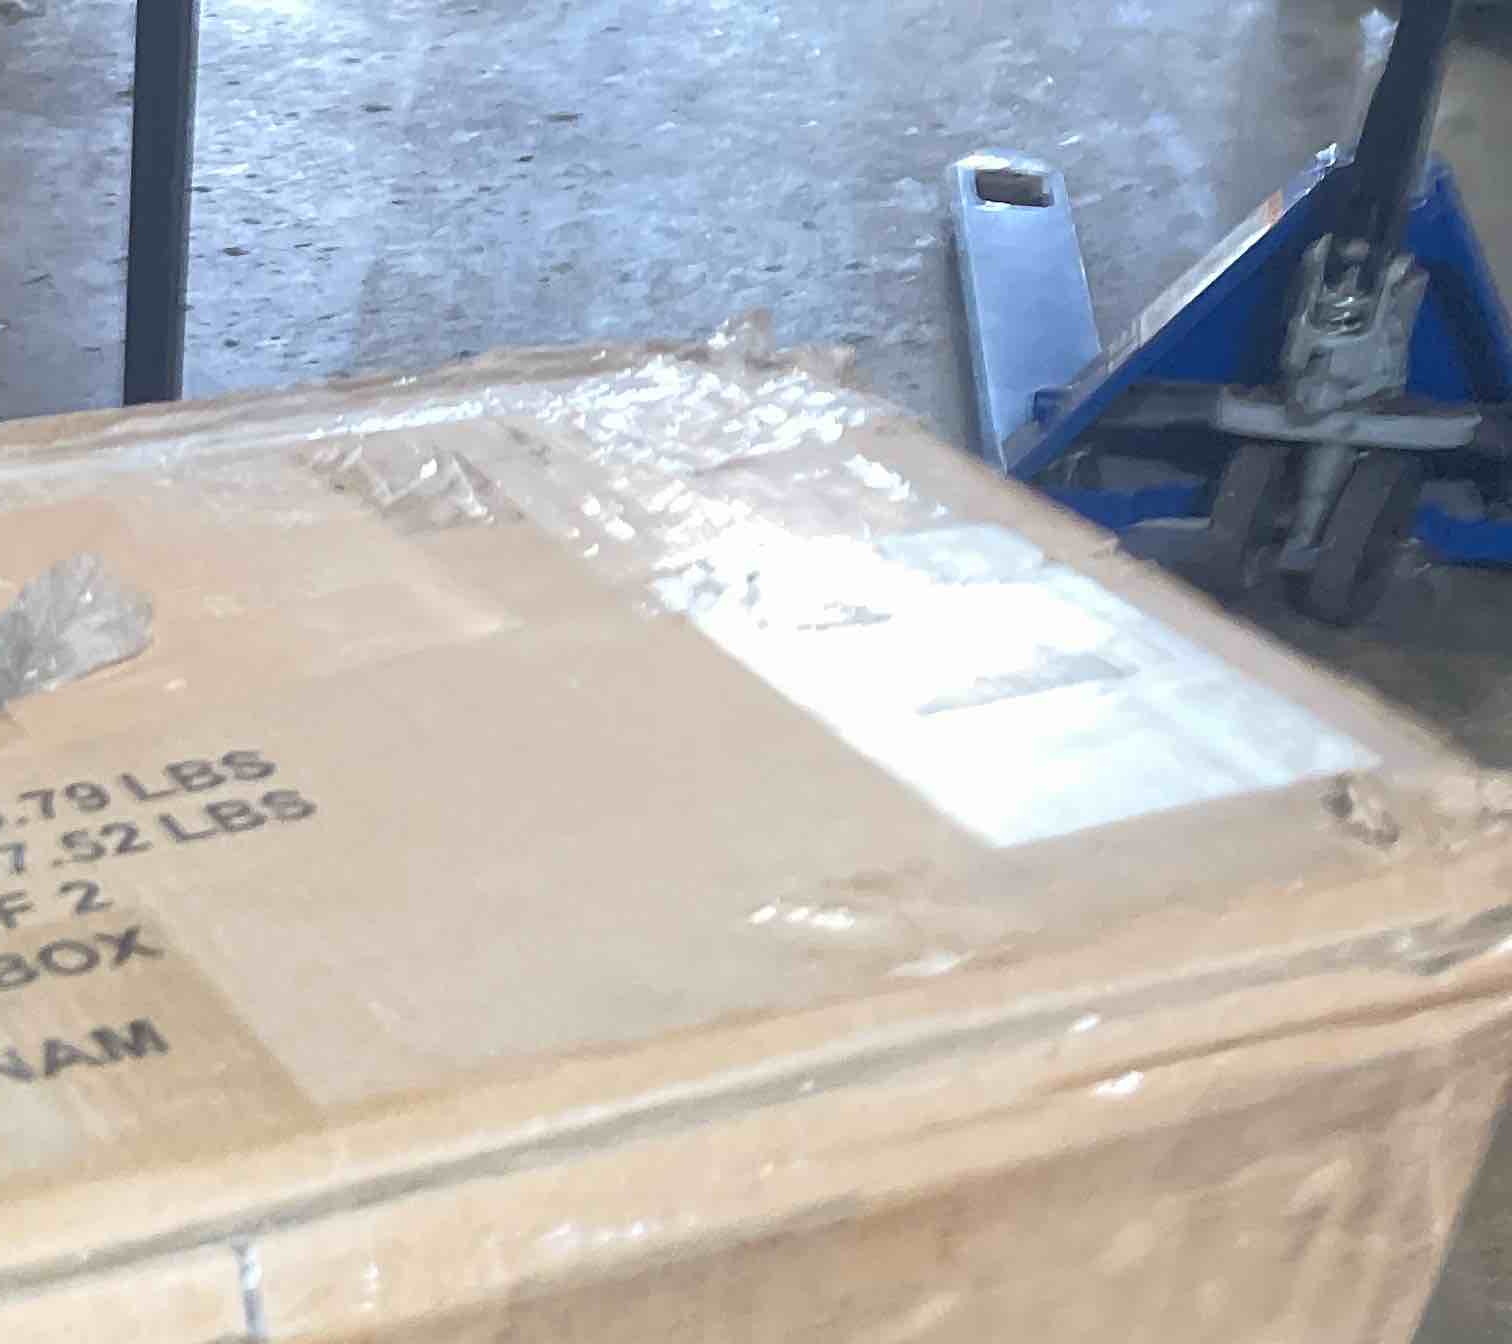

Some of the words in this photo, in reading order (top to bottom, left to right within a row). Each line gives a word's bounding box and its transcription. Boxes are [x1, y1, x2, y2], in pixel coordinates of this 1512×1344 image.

[118, 748, 277, 802] LBS
[158, 786, 318, 845] LBS
[58, 878, 115, 918] 2
